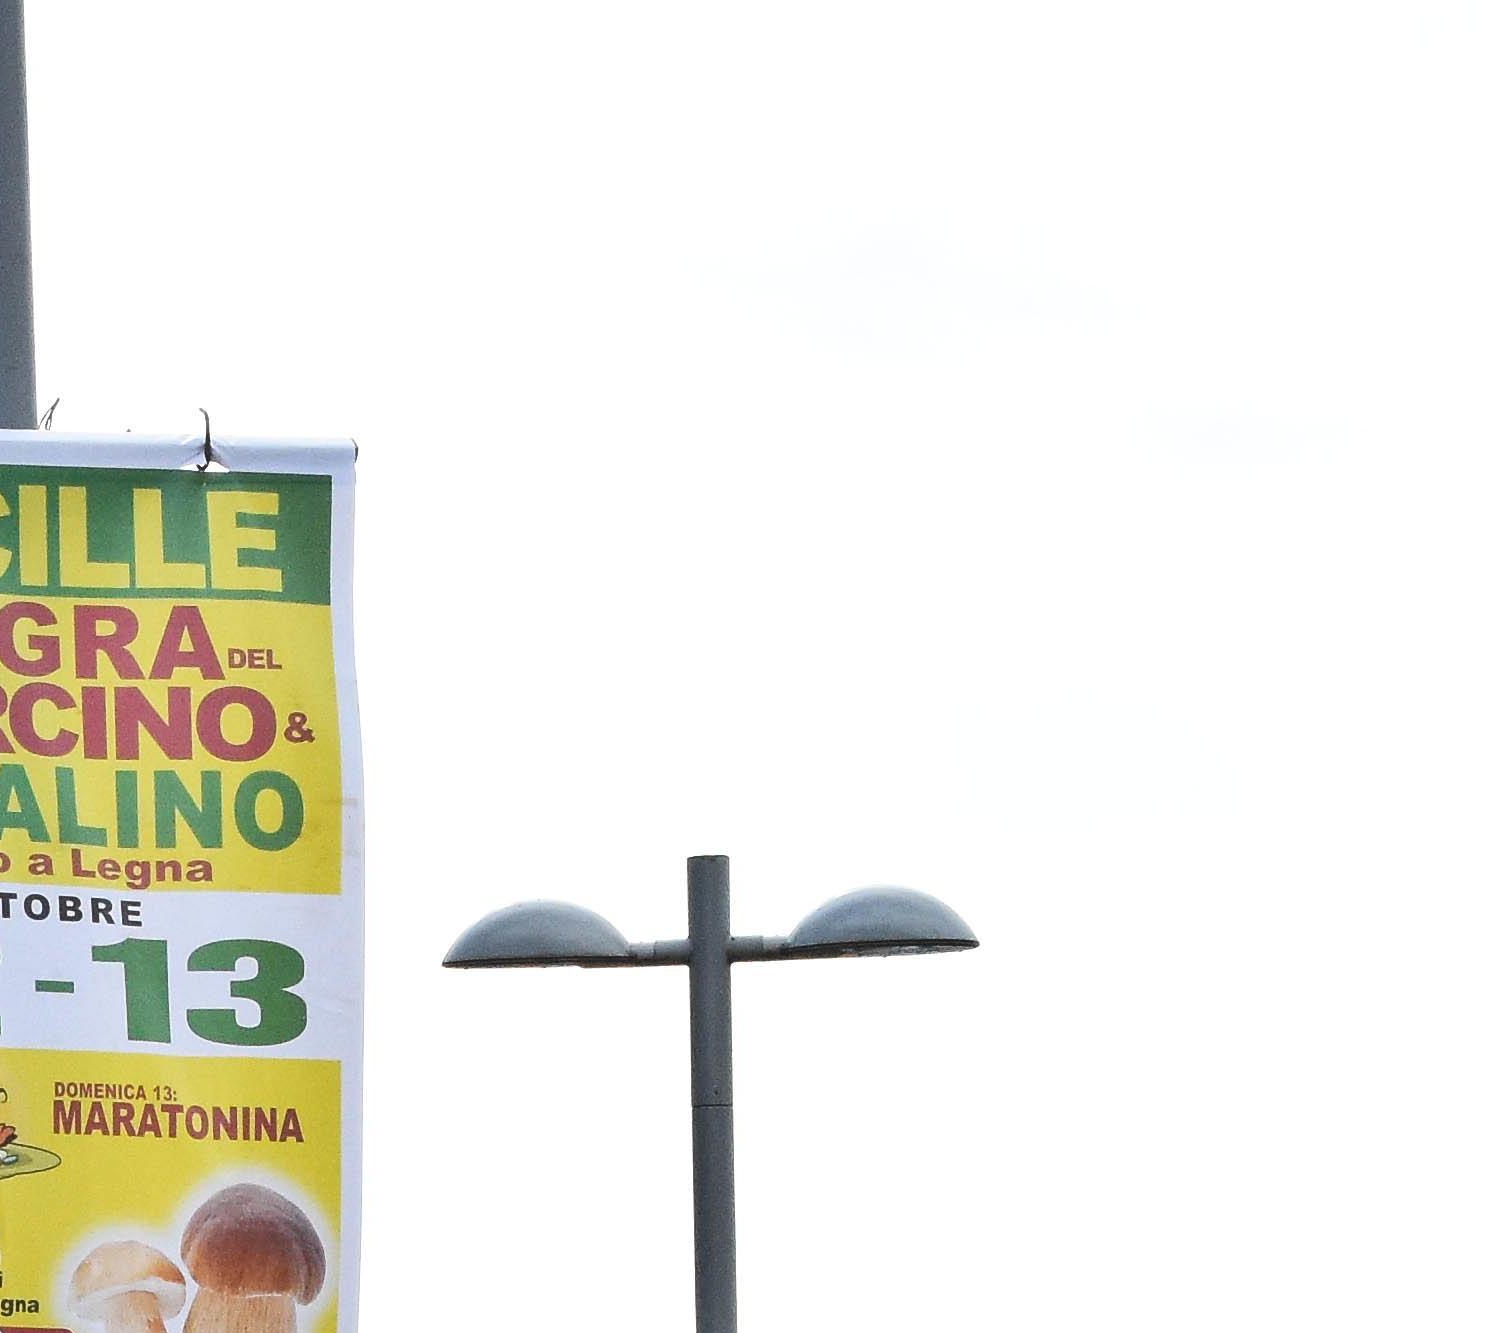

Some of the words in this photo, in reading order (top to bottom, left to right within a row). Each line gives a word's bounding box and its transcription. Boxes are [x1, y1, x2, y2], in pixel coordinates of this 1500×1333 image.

[227, 648, 282, 669] DEL
[284, 712, 315, 743] &
[29, 854, 54, 876] a
[72, 849, 213, 890] Legna
[54, 1082, 147, 1101] DOMENICA
[153, 1085, 178, 1102] 13:
[52, 1100, 305, 1143] MARATONINA
